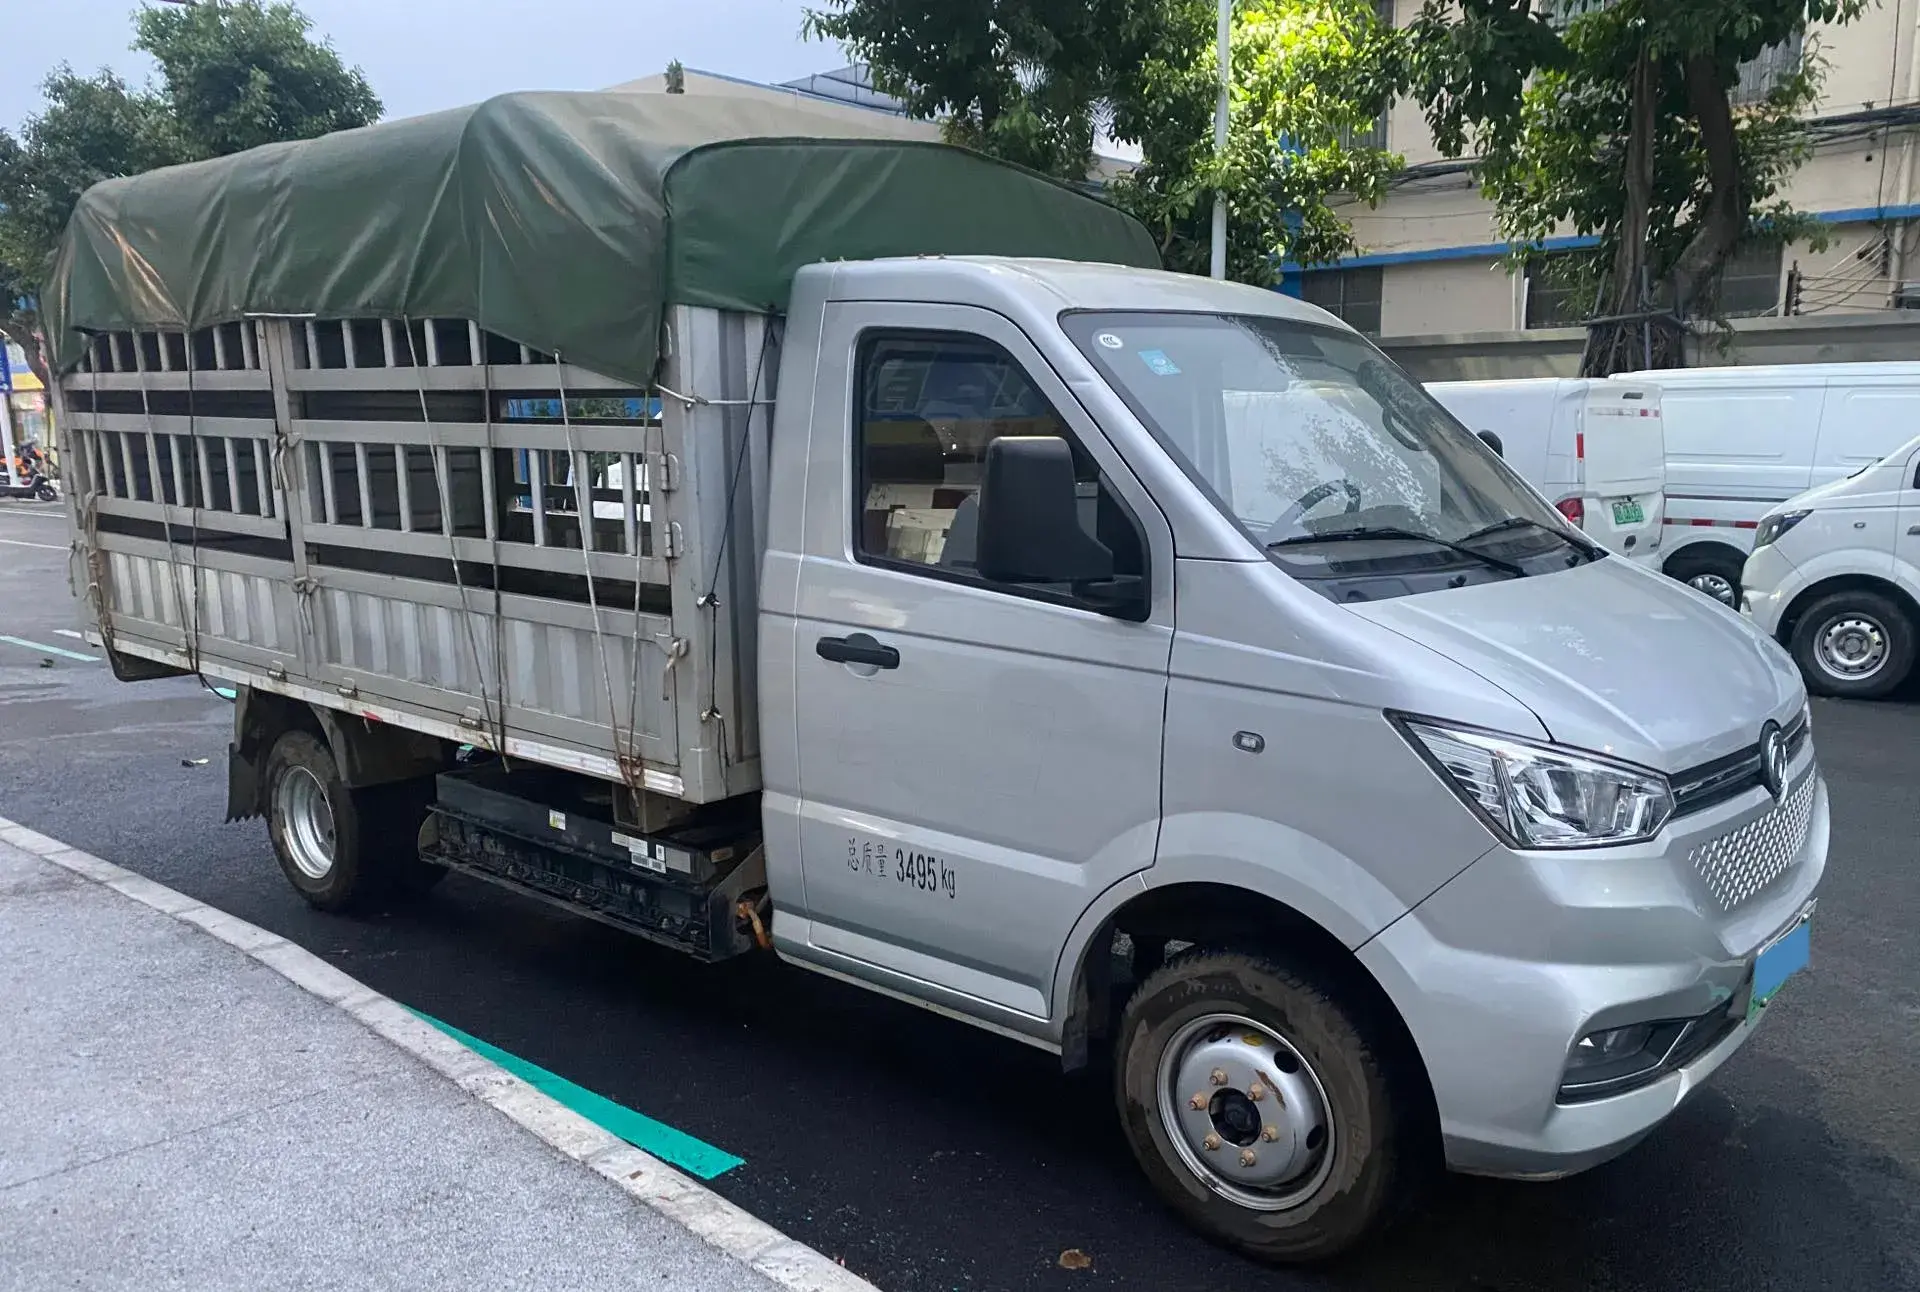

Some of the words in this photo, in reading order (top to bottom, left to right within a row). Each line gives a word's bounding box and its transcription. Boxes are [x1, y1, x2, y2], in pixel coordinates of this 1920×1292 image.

[847, 838, 888, 878] 总质量
[896, 848, 937, 892] 3495
[940, 858, 956, 899] kg
